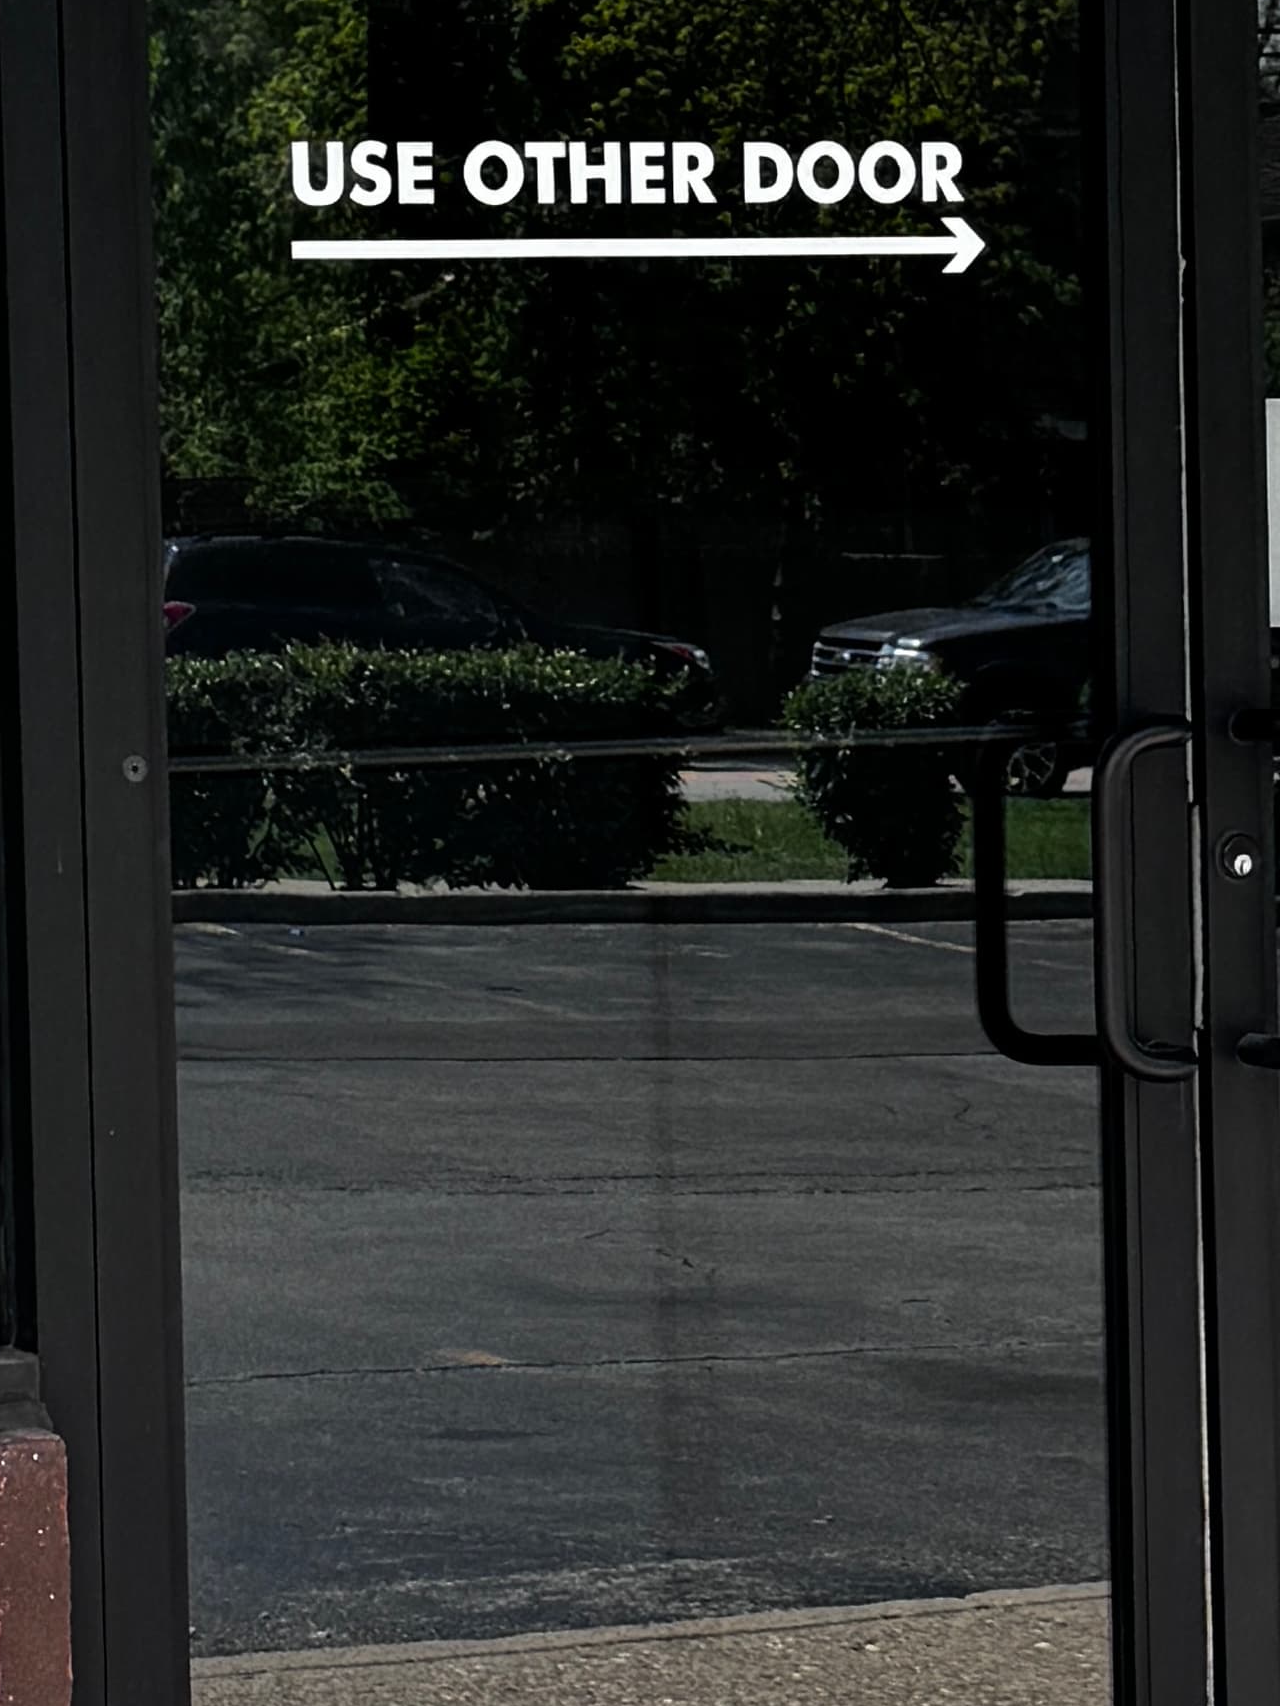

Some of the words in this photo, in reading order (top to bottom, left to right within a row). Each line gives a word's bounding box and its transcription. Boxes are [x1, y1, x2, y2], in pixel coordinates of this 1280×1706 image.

[291, 140, 435, 207] USE
[463, 140, 717, 206] OTHER
[743, 140, 965, 205] DOOR
